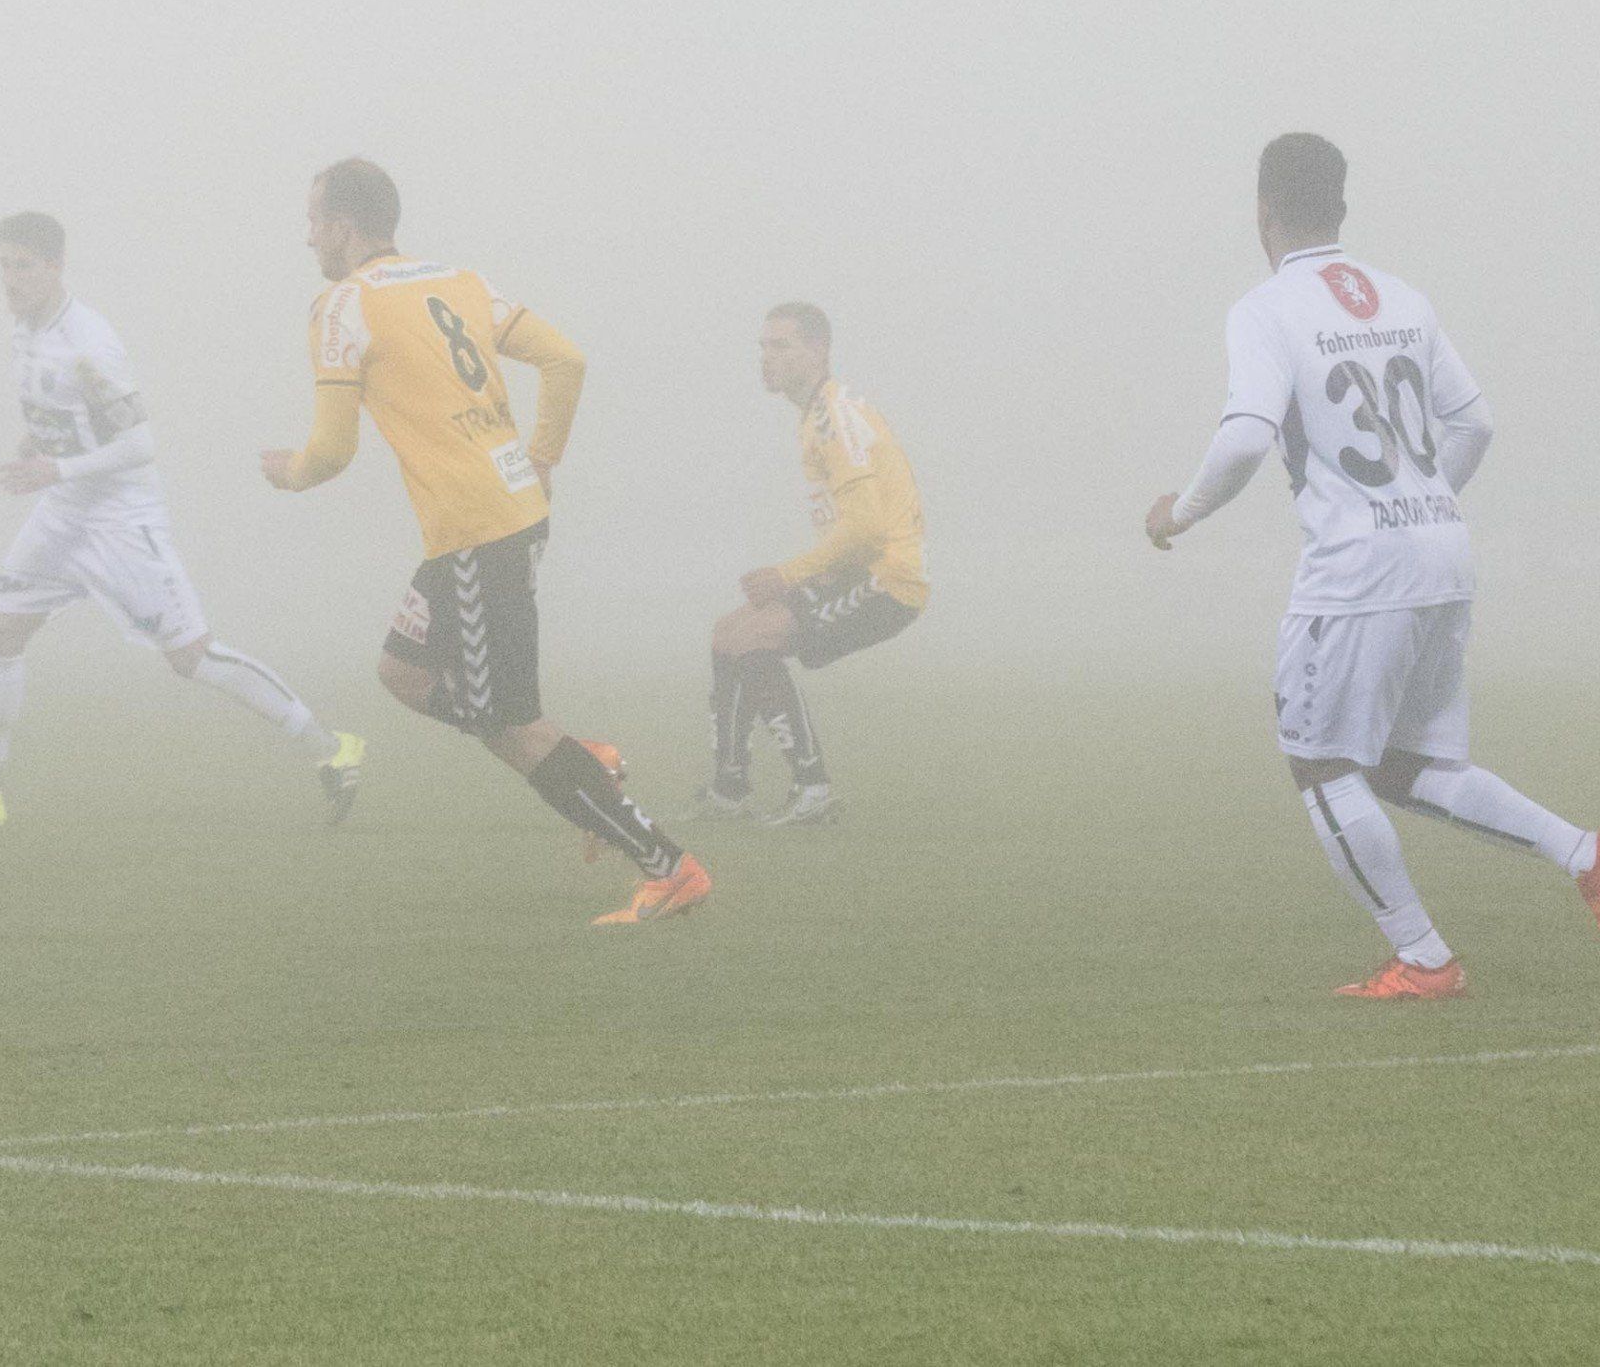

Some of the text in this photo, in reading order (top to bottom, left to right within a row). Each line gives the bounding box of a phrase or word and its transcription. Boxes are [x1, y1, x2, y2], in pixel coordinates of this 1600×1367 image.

[427, 296, 490, 394] 8
[1315, 326, 1423, 356] fohrenburger
[1325, 354, 1438, 488] 30
